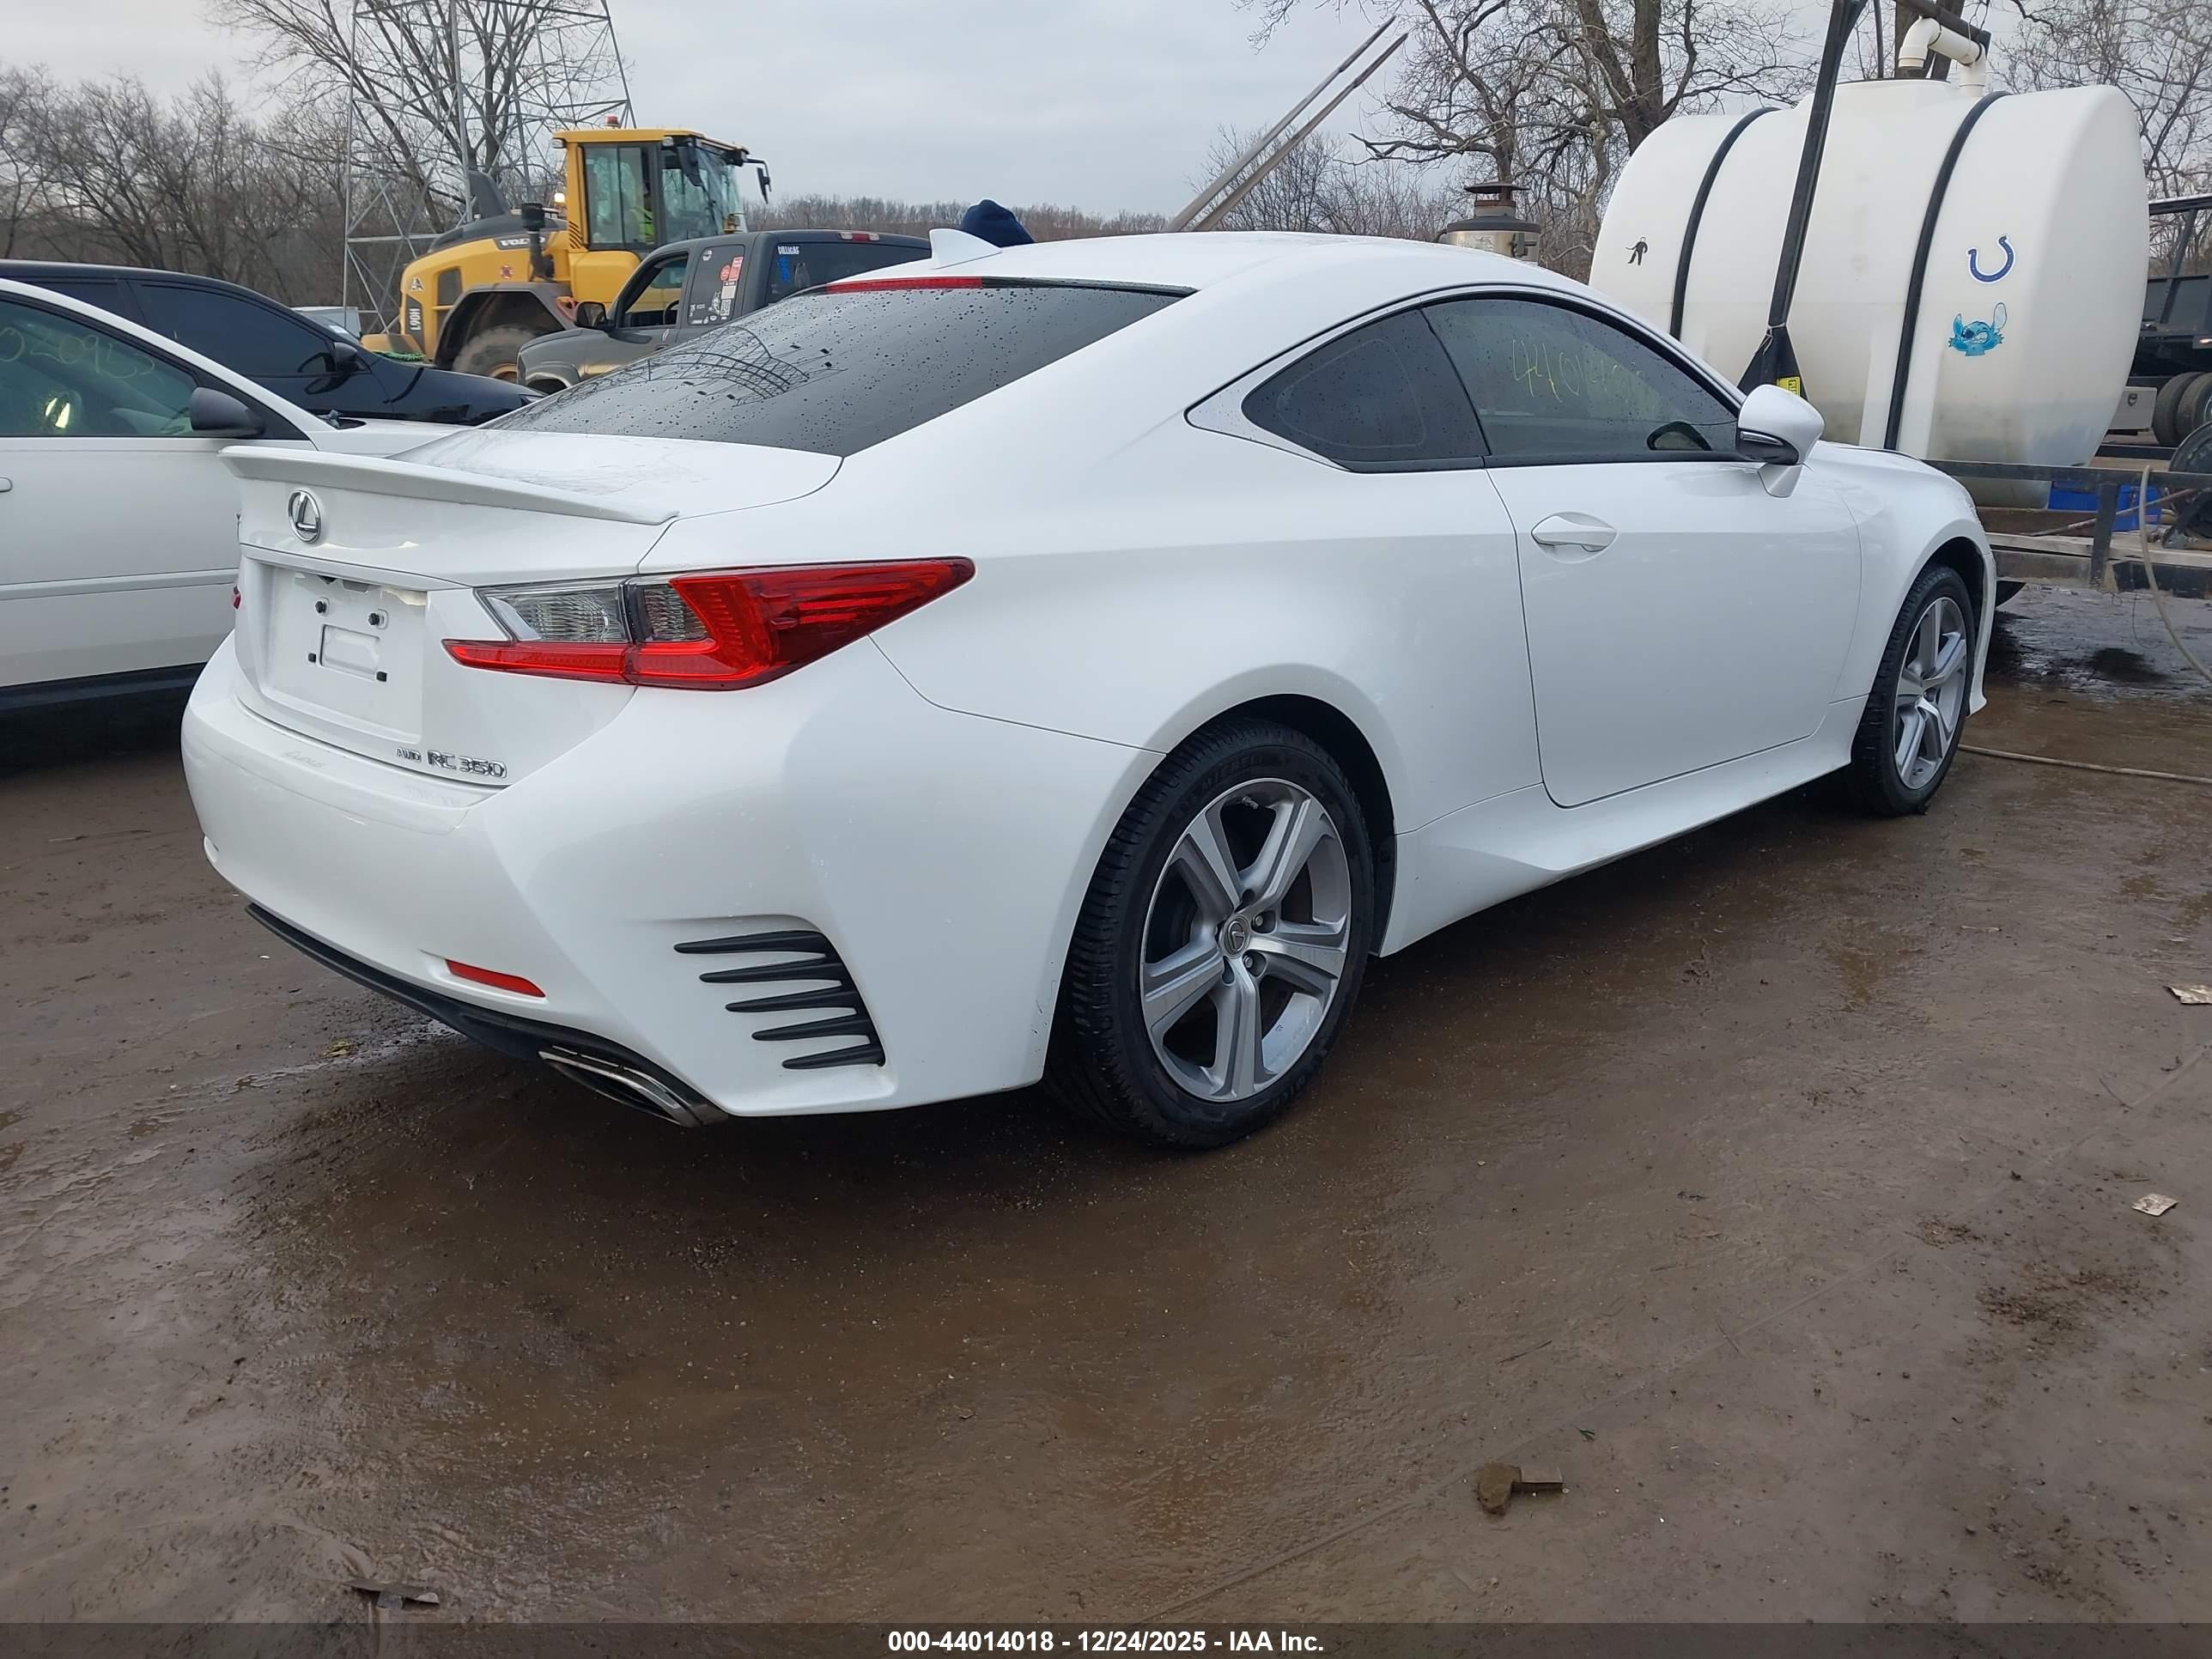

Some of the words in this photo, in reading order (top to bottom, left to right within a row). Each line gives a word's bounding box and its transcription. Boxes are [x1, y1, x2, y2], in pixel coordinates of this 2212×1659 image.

[500, 236, 546, 246] VOLO
[396, 746, 422, 763] AWD
[427, 749, 457, 771] RC
[458, 756, 507, 780] 350
